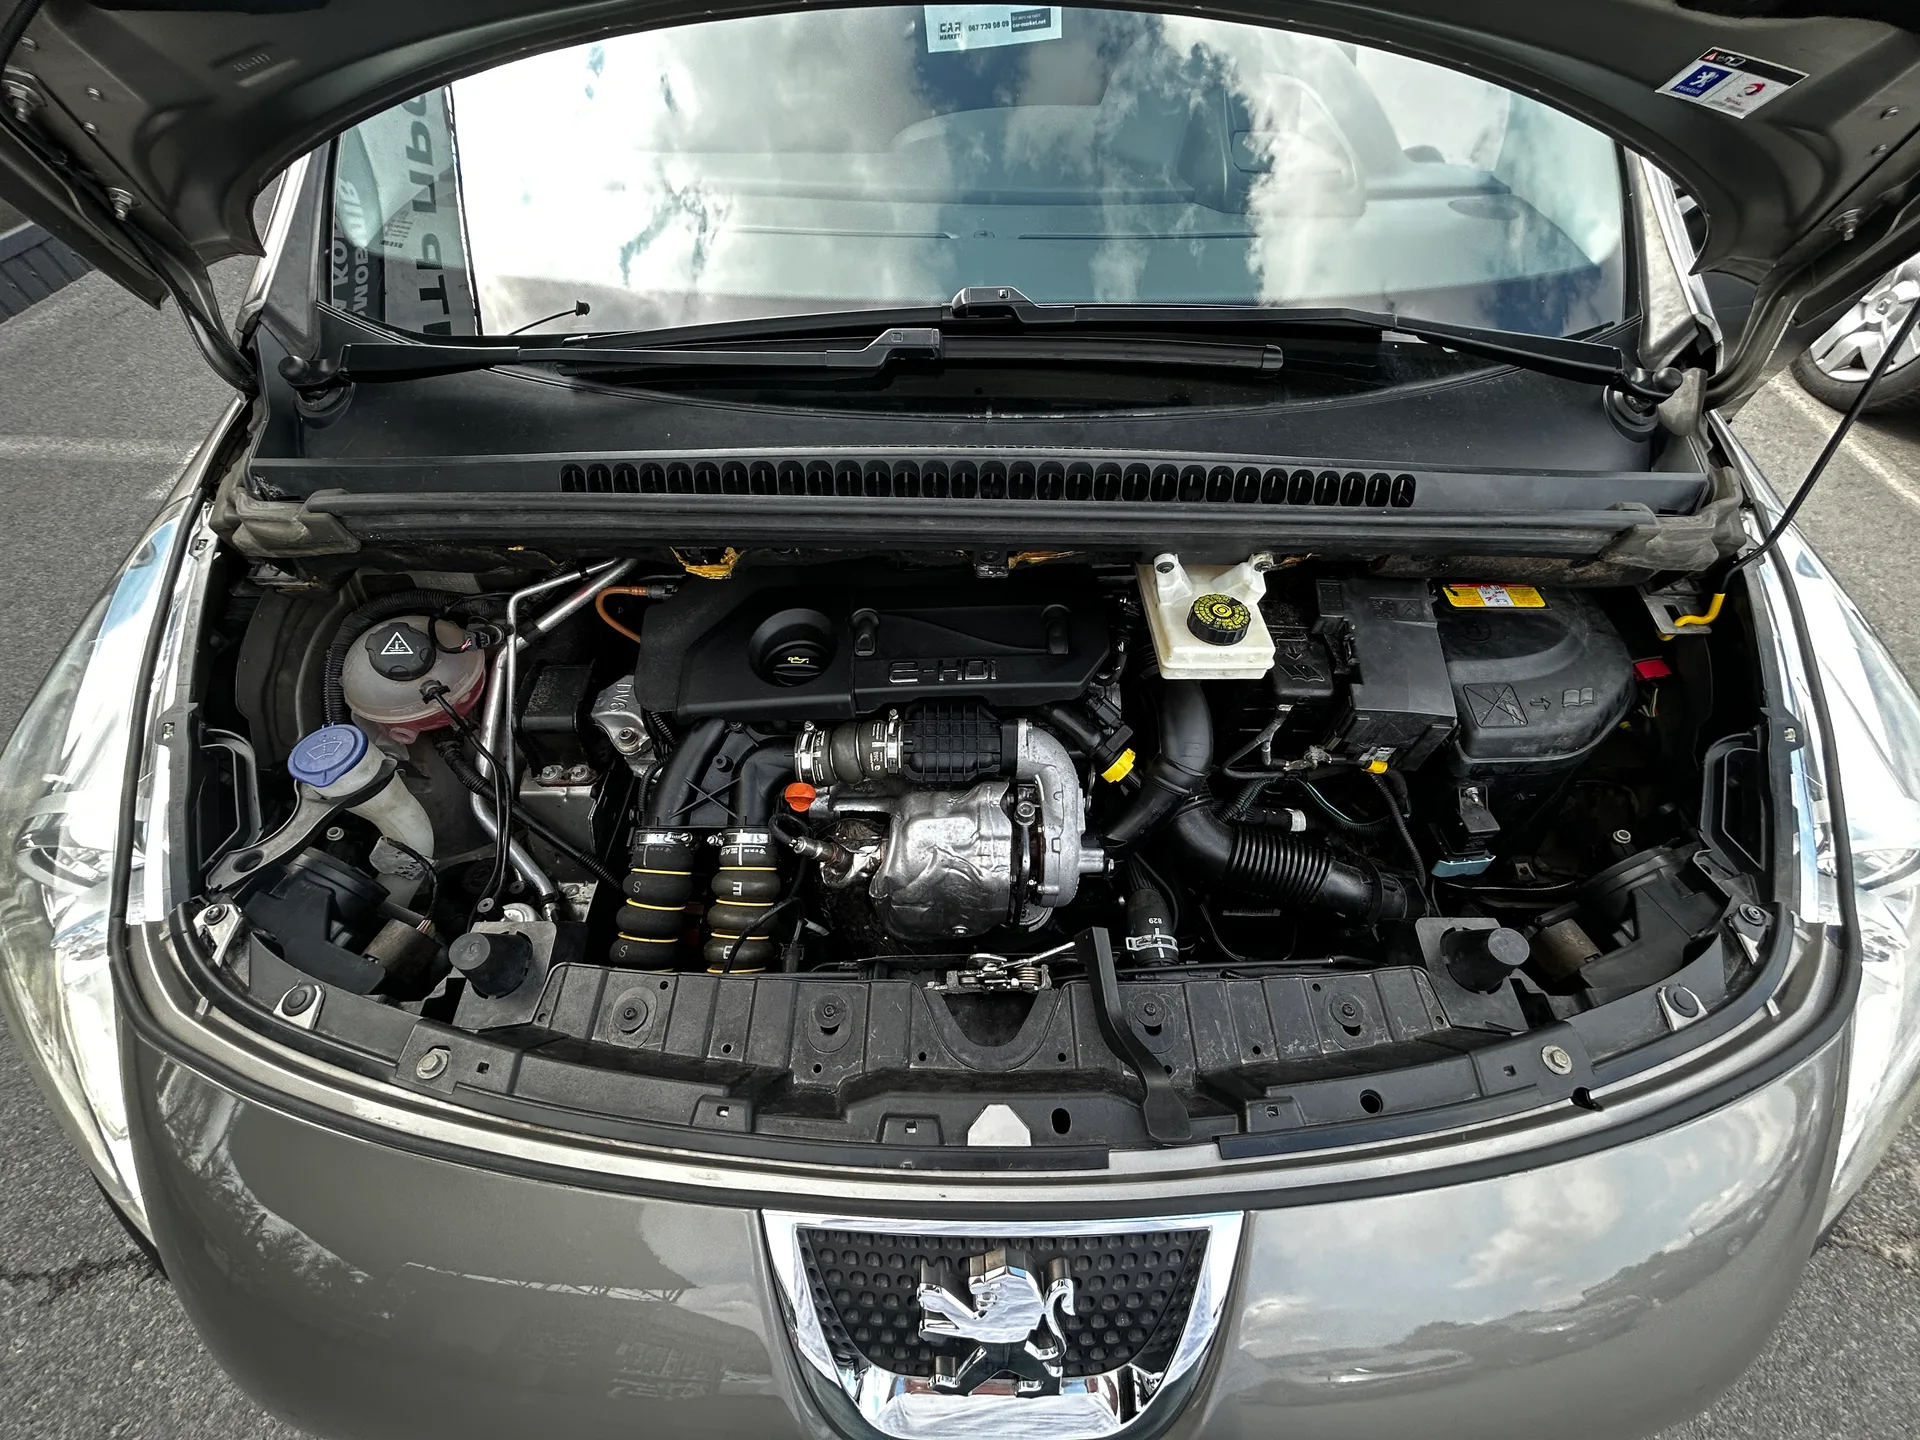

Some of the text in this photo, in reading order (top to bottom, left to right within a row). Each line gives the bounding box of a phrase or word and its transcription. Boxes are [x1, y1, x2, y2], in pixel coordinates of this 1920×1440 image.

[940, 22, 961, 33] CAR
[940, 33, 961, 41] MARKET
[1676, 85, 1702, 95] PEUGEOT
[609, 683, 633, 712] DV6
[633, 881, 642, 893] S
[618, 946, 628, 959] S
